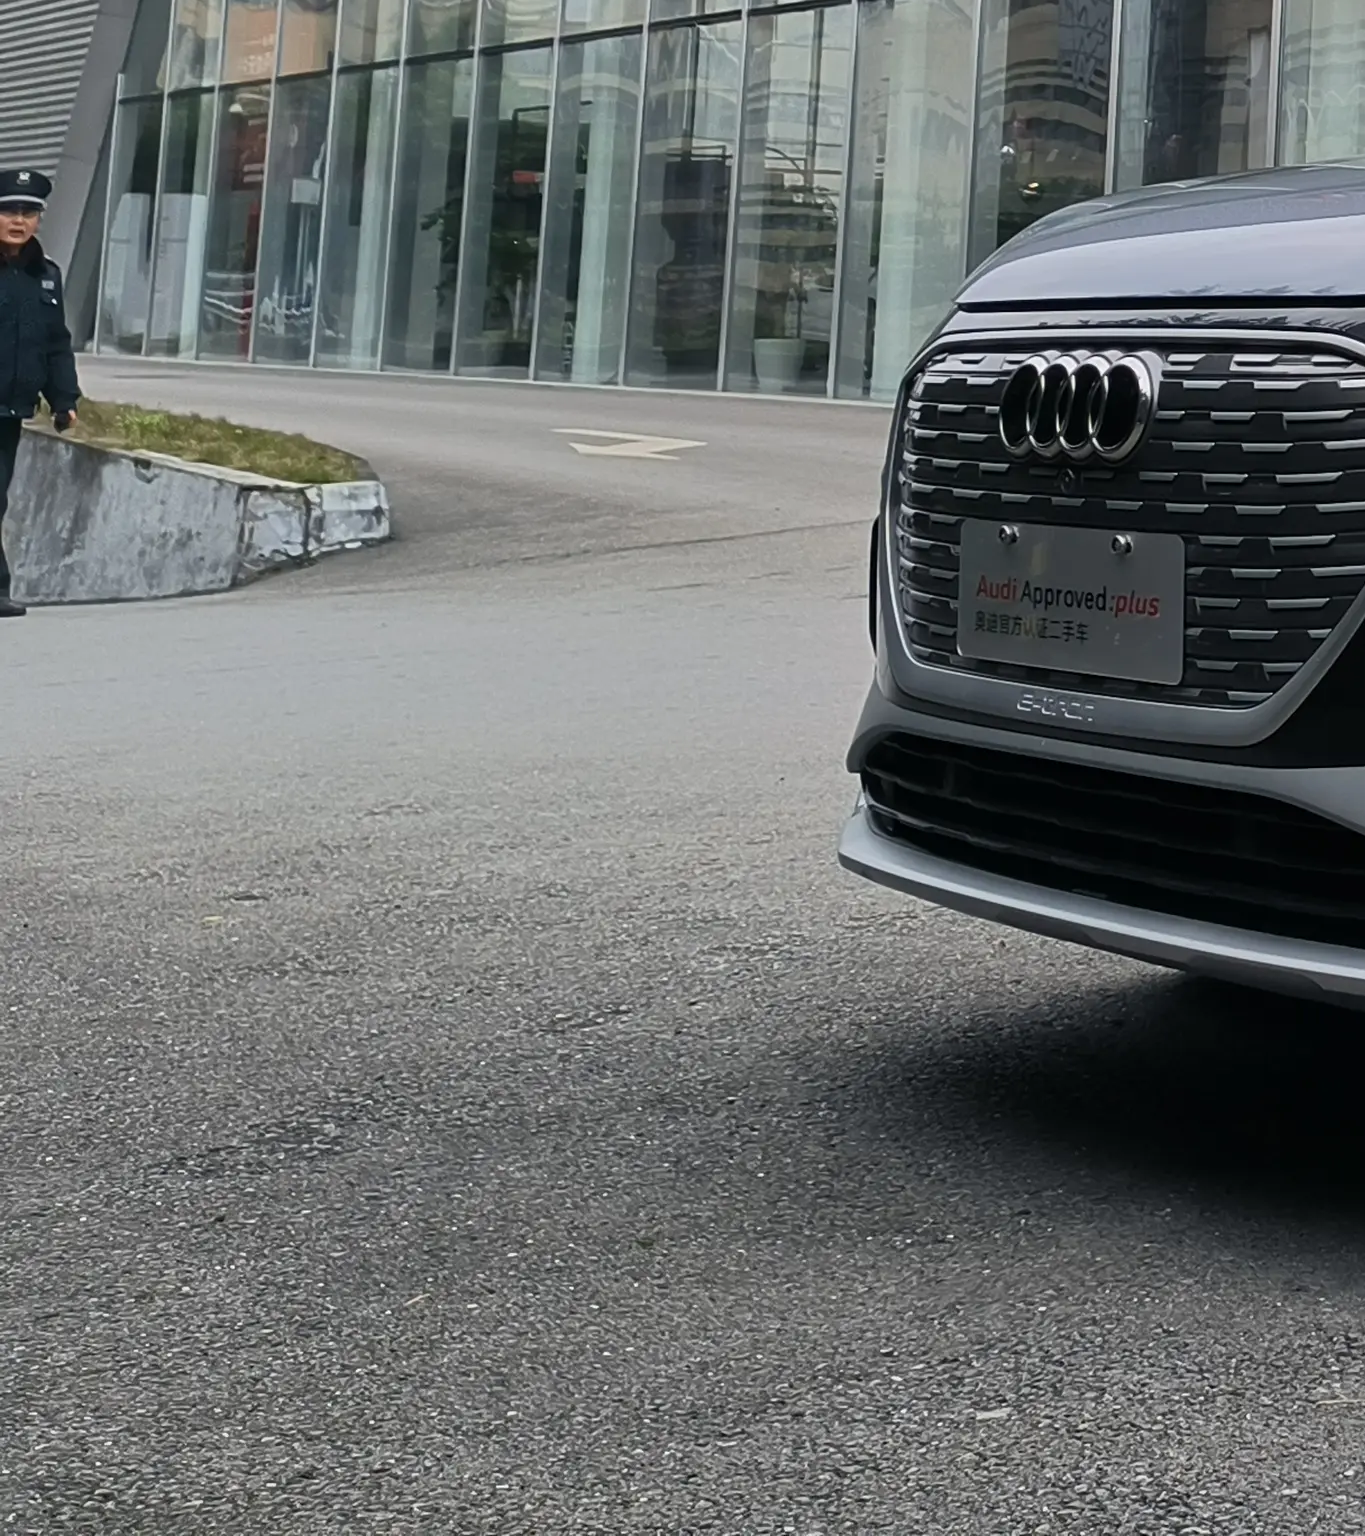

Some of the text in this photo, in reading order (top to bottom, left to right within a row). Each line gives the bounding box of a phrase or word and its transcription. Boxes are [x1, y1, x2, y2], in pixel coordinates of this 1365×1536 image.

[976, 574, 1018, 601] Audi
[974, 610, 1090, 645] 奥迪官方认证二手车
